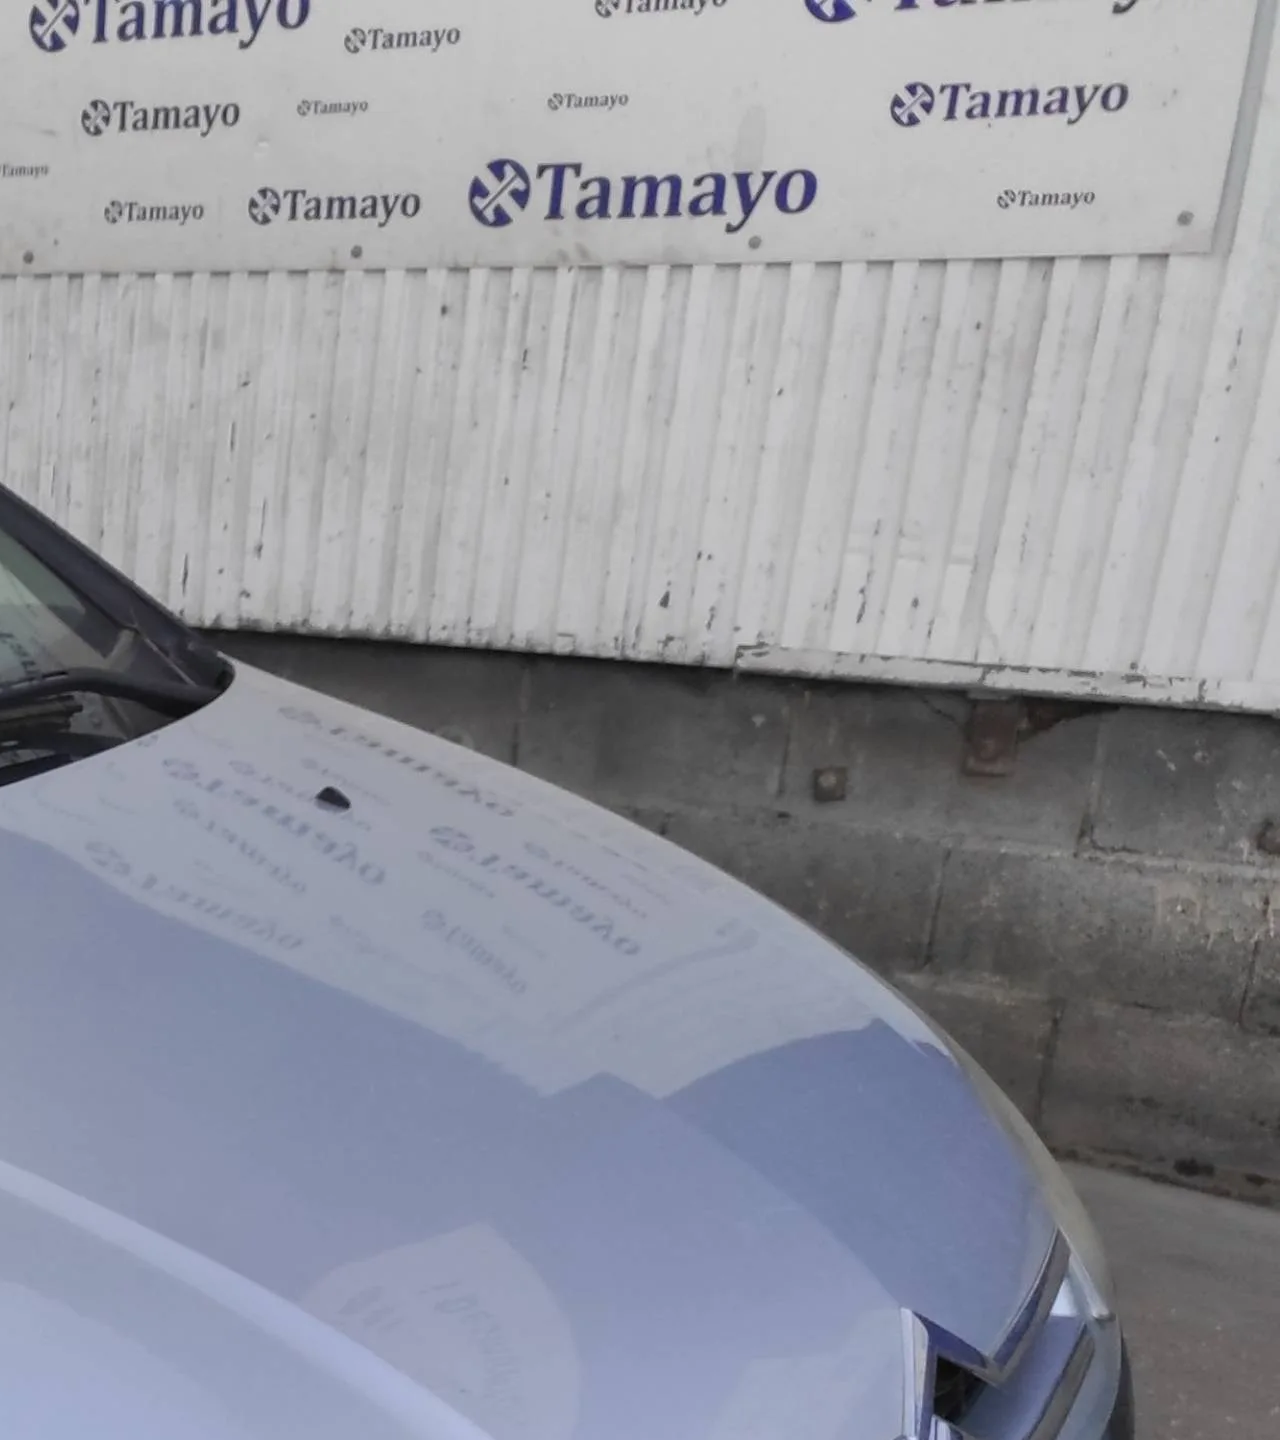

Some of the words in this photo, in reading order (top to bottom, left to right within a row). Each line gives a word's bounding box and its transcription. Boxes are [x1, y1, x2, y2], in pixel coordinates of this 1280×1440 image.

[84, 0, 310, 50] Tamayo
[368, 27, 460, 52] Tamayo
[311, 99, 368, 117] Tamayo
[564, 92, 629, 110] Tamayo
[939, 82, 1129, 125] Tamayo
[113, 101, 240, 137] Tamayo
[124, 201, 204, 225] Tamayo
[283, 189, 421, 227] Tamayo
[536, 163, 817, 233] Tamayo
[1018, 188, 1096, 208] Tamayo
